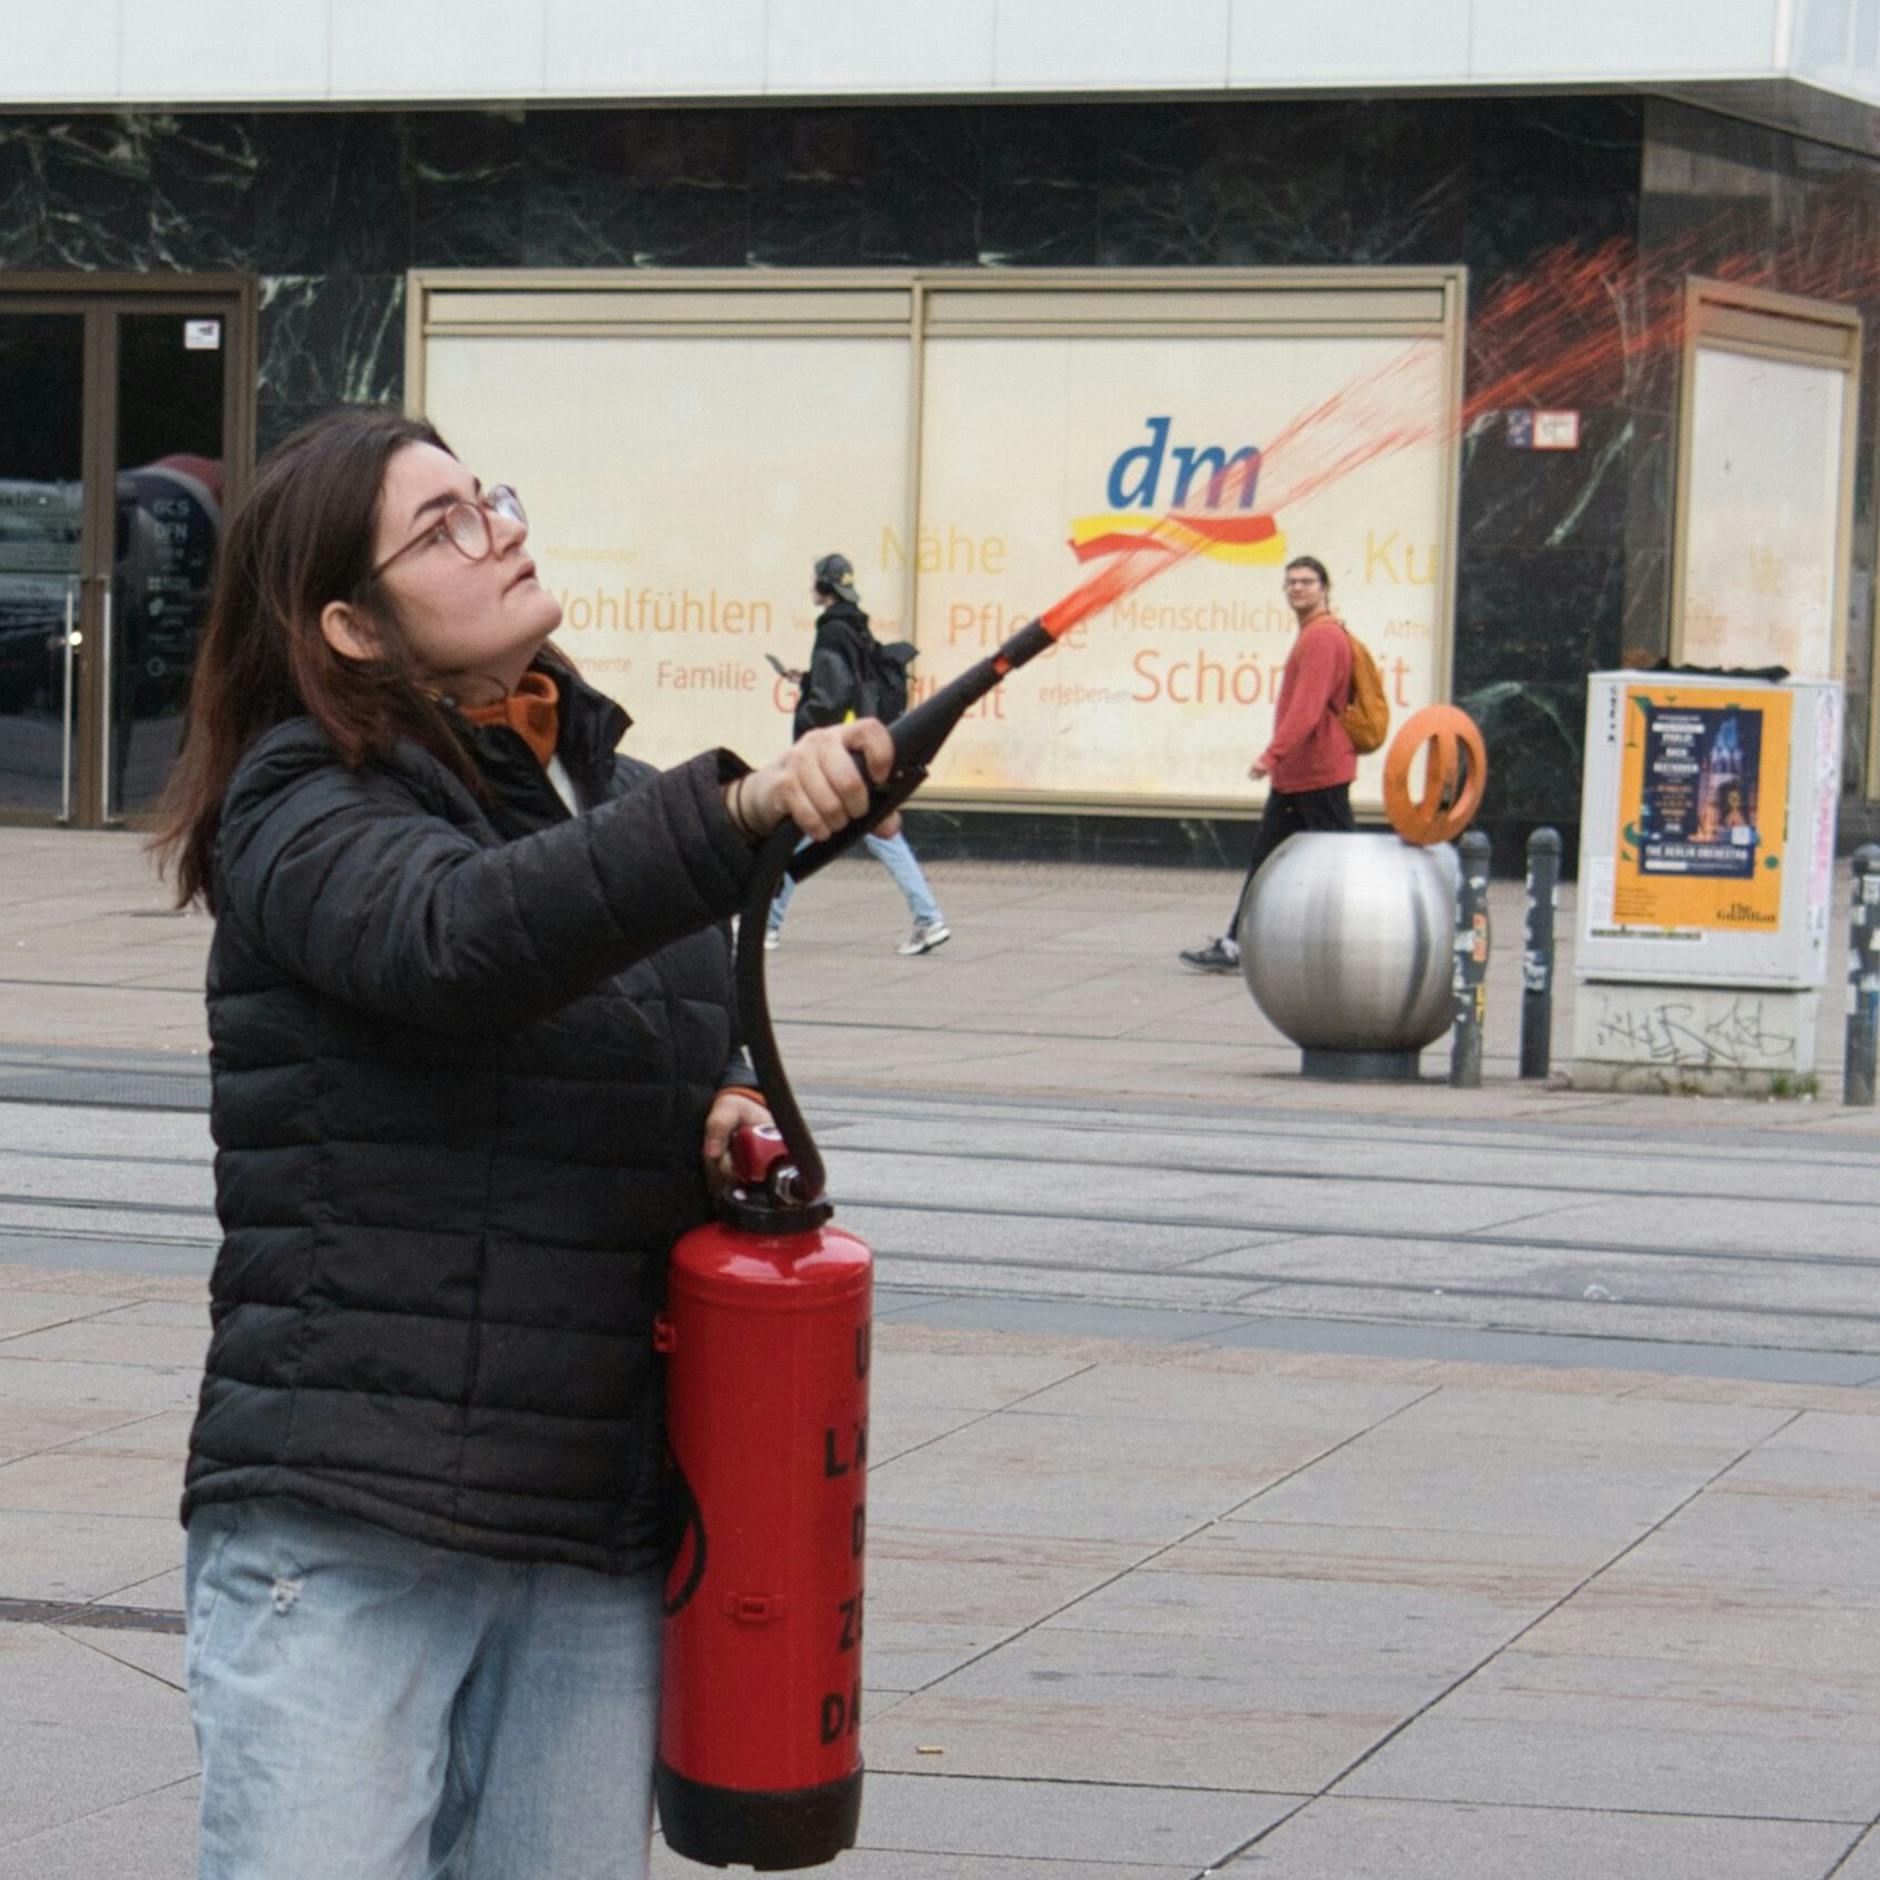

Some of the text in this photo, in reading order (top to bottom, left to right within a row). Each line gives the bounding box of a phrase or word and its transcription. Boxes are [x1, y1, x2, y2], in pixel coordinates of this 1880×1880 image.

[1107, 417, 1262, 509] dm
[880, 523, 1008, 575] Nähe
[561, 586, 772, 634] ohlfühlen
[657, 660, 758, 691] Familie
